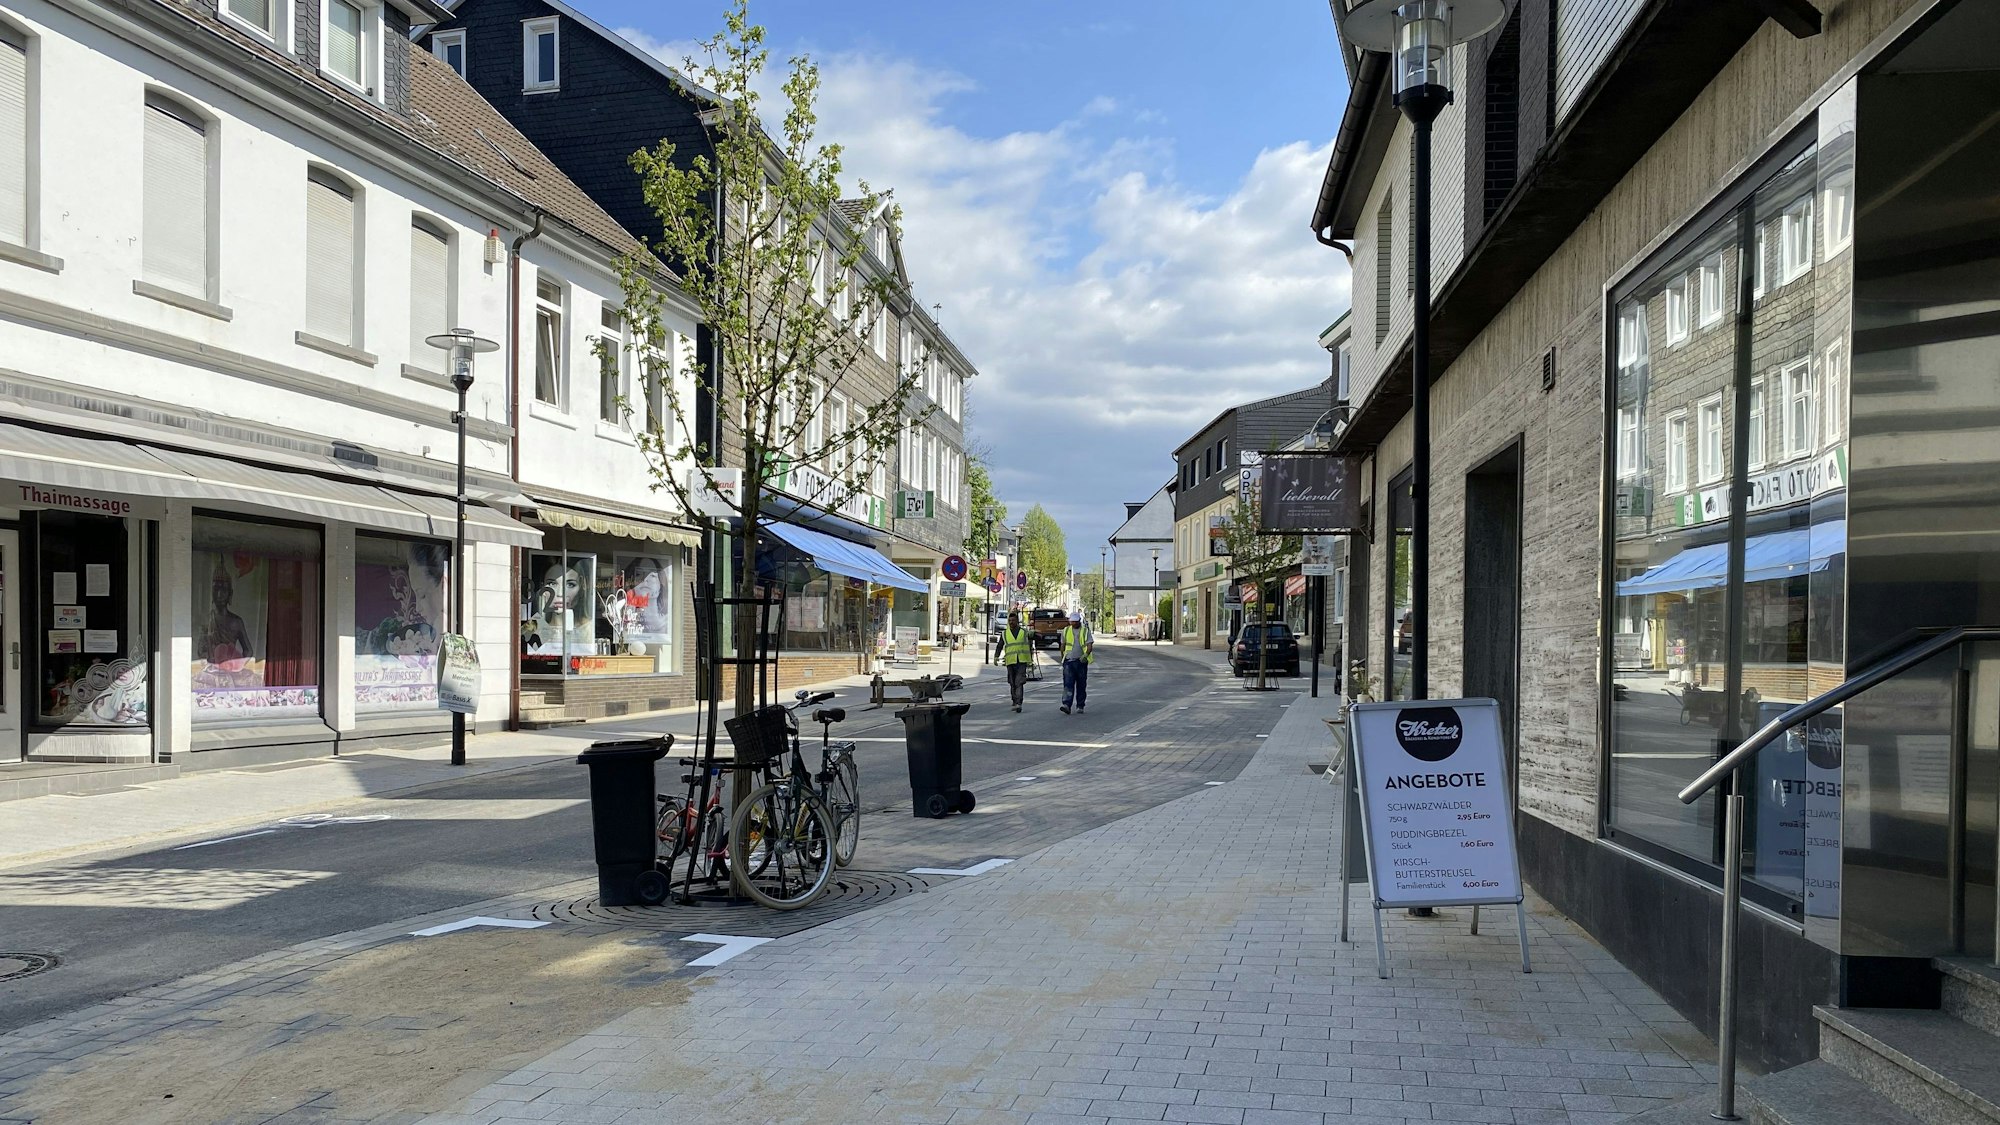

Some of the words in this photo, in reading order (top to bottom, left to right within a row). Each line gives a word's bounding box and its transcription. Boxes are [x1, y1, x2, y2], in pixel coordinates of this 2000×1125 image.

[805, 471, 825, 501] FOTO
[1280, 486, 1343, 501] liebevoll
[19, 485, 131, 514] Thaimassage
[1399, 720, 1459, 739] Kretzer
[1385, 773, 1486, 789] ANGEBOTE
[1387, 801, 1472, 811] SCHWARZWÄLDER
[1473, 812, 1491, 820] Euro
[1390, 829, 1468, 839] PUDDINGBREZEL
[1391, 842, 1412, 850] Stück
[1393, 858, 1431, 866] KIRSCH-
[1395, 869, 1475, 879] BUTTERSTREUSEL
[1396, 882, 1446, 890] Familienstück
[1462, 881, 1480, 889] 6,00
